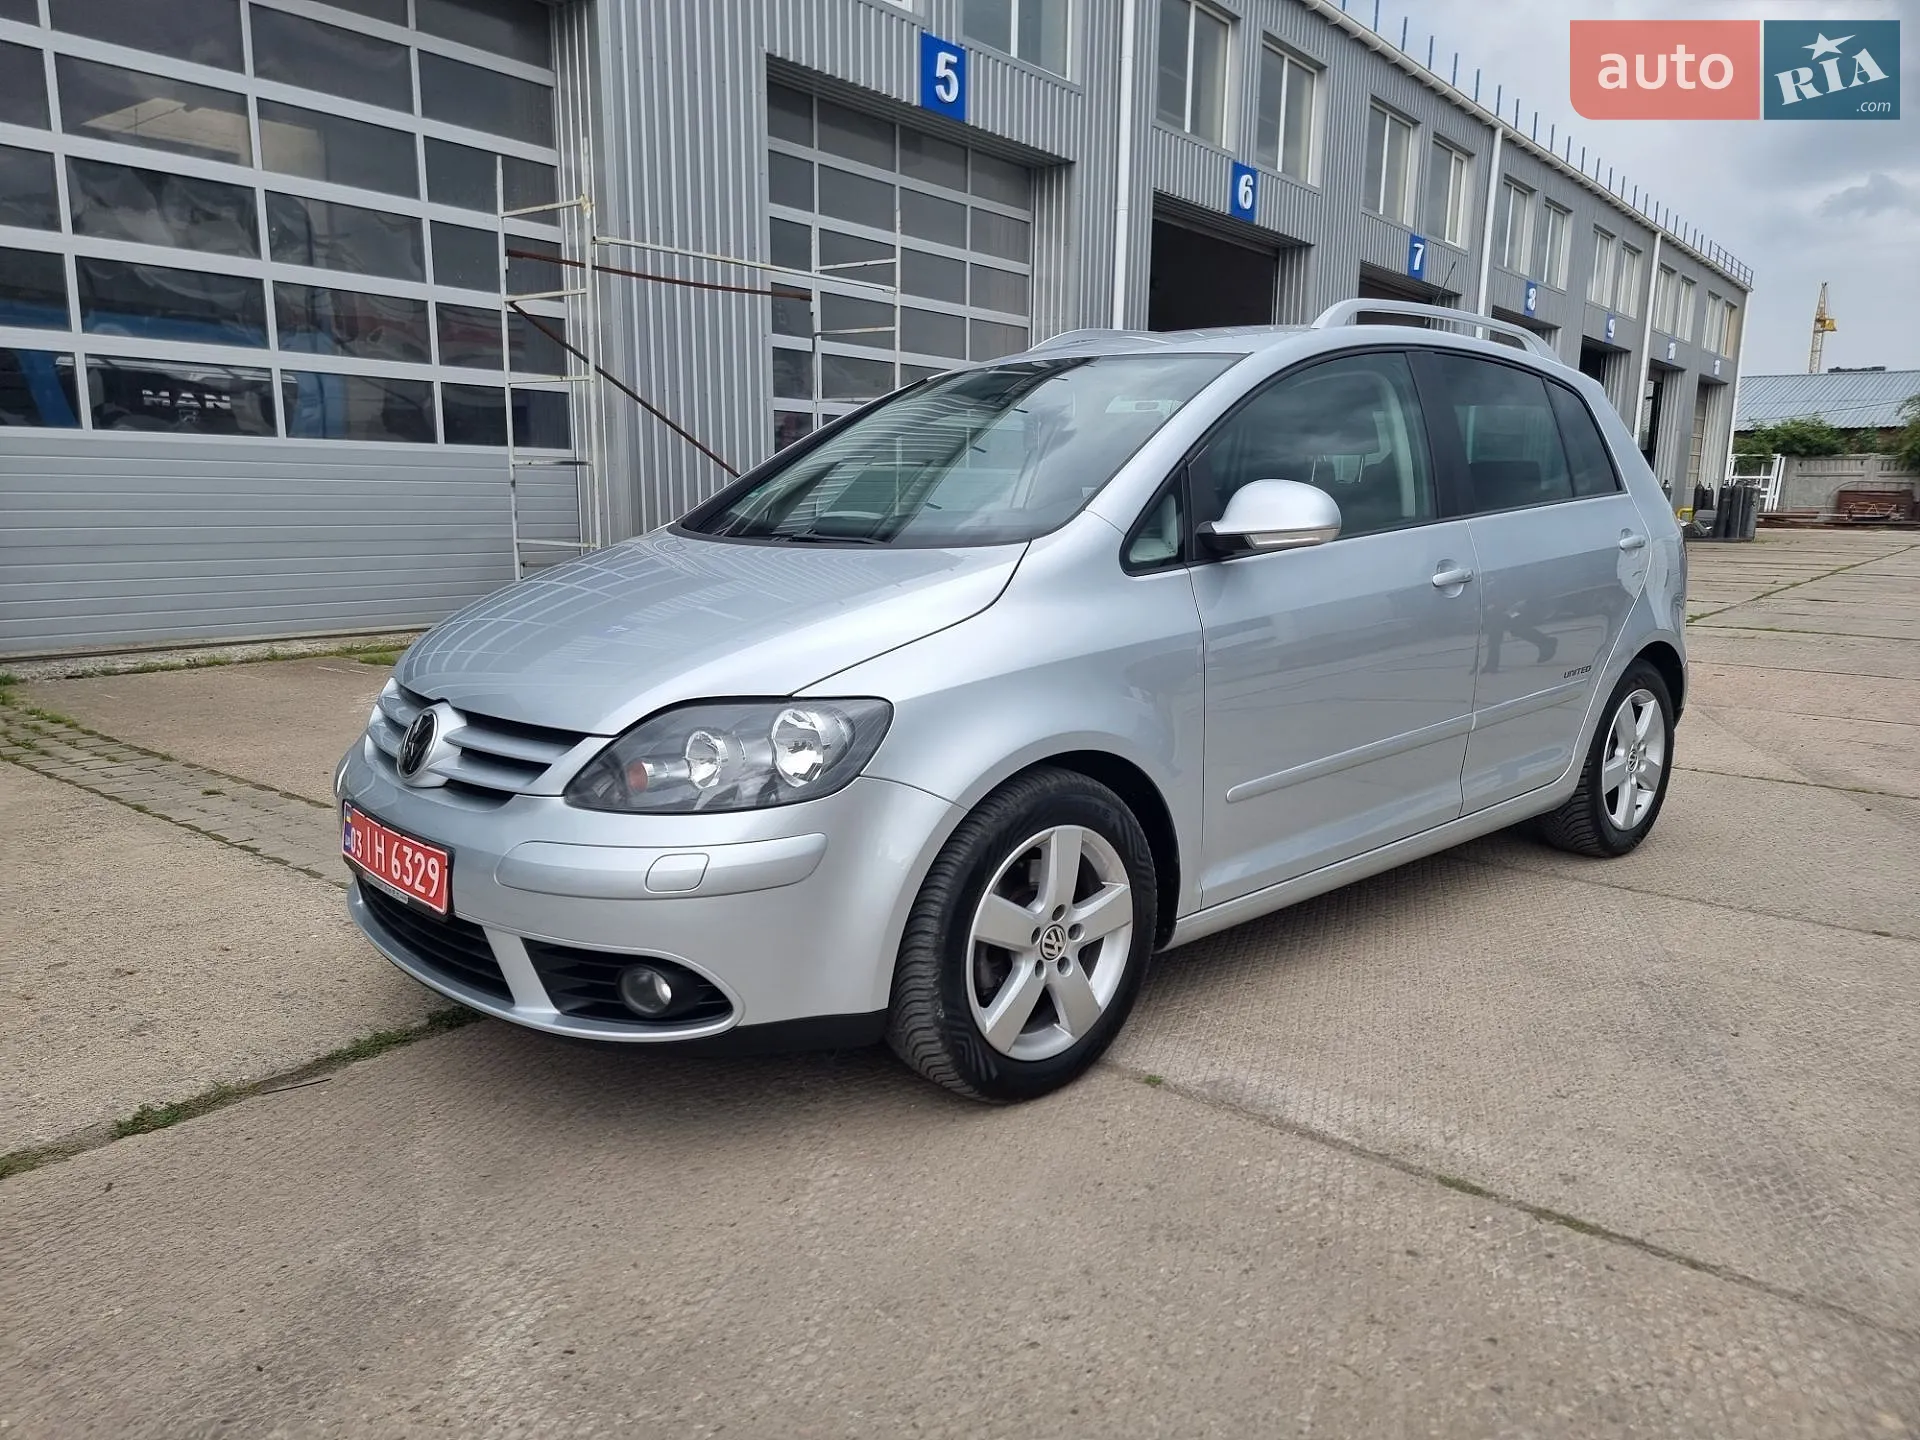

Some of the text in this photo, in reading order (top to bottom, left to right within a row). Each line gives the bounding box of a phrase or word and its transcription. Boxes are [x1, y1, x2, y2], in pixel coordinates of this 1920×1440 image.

[935, 51, 959, 103] 5
[1238, 174, 1254, 210] 6
[1413, 243, 1425, 271] 7
[1527, 287, 1537, 311] 8
[142, 389, 232, 410] MAN
[1563, 664, 1592, 679] UNITED
[350, 826, 363, 859] 03
[367, 826, 386, 873] IH
[391, 841, 440, 898] 6329
